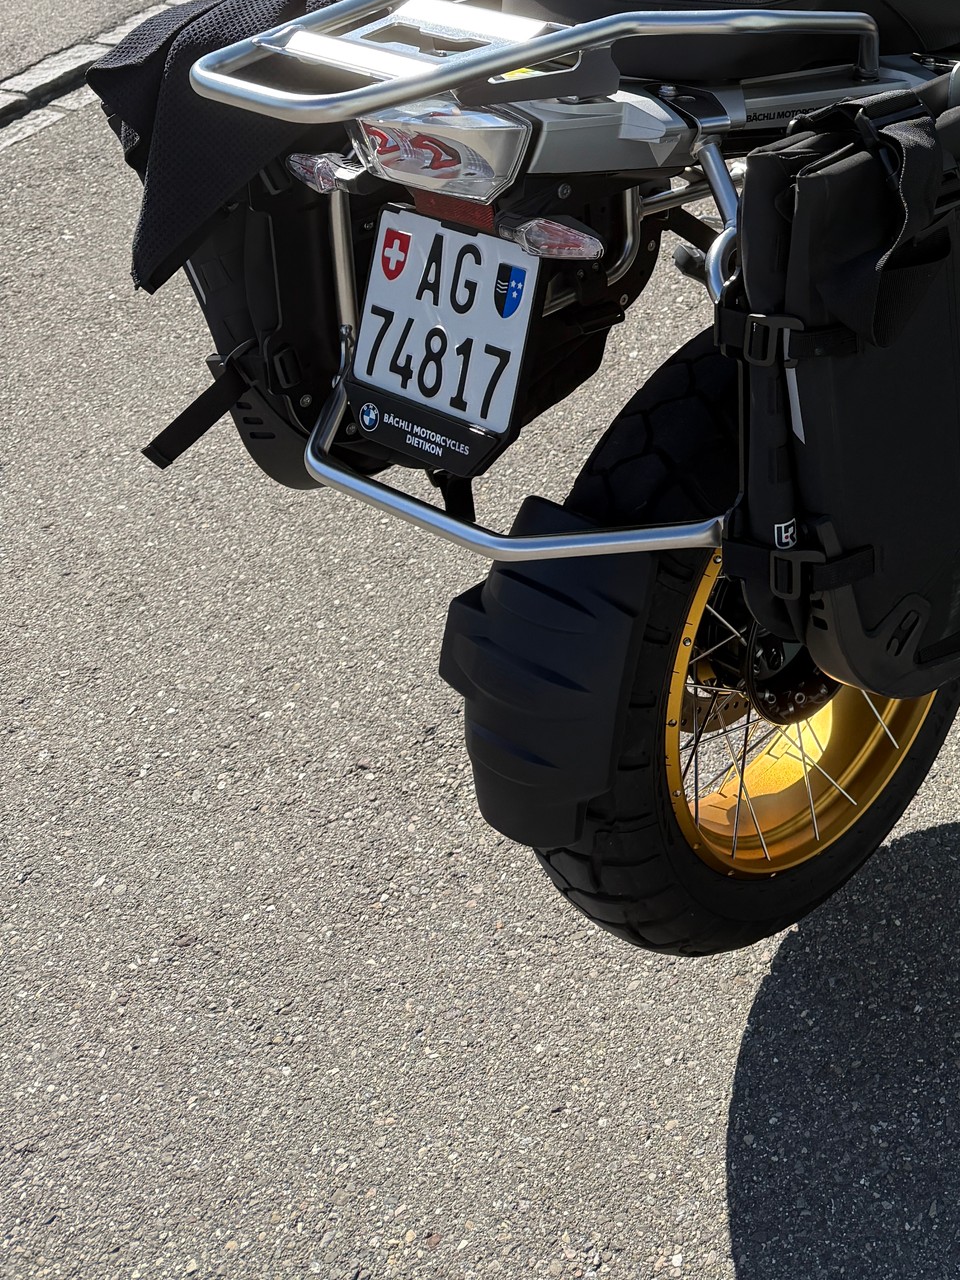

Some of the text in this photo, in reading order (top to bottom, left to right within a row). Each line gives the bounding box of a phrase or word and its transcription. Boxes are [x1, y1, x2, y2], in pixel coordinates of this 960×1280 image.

[746, 110, 776, 122] BÄCHLI
[415, 233, 482, 314] AG
[366, 305, 511, 419] 74817
[383, 413, 470, 456] BÄCHLI MOTORCYCLES
[406, 434, 443, 457] DIETIKON
